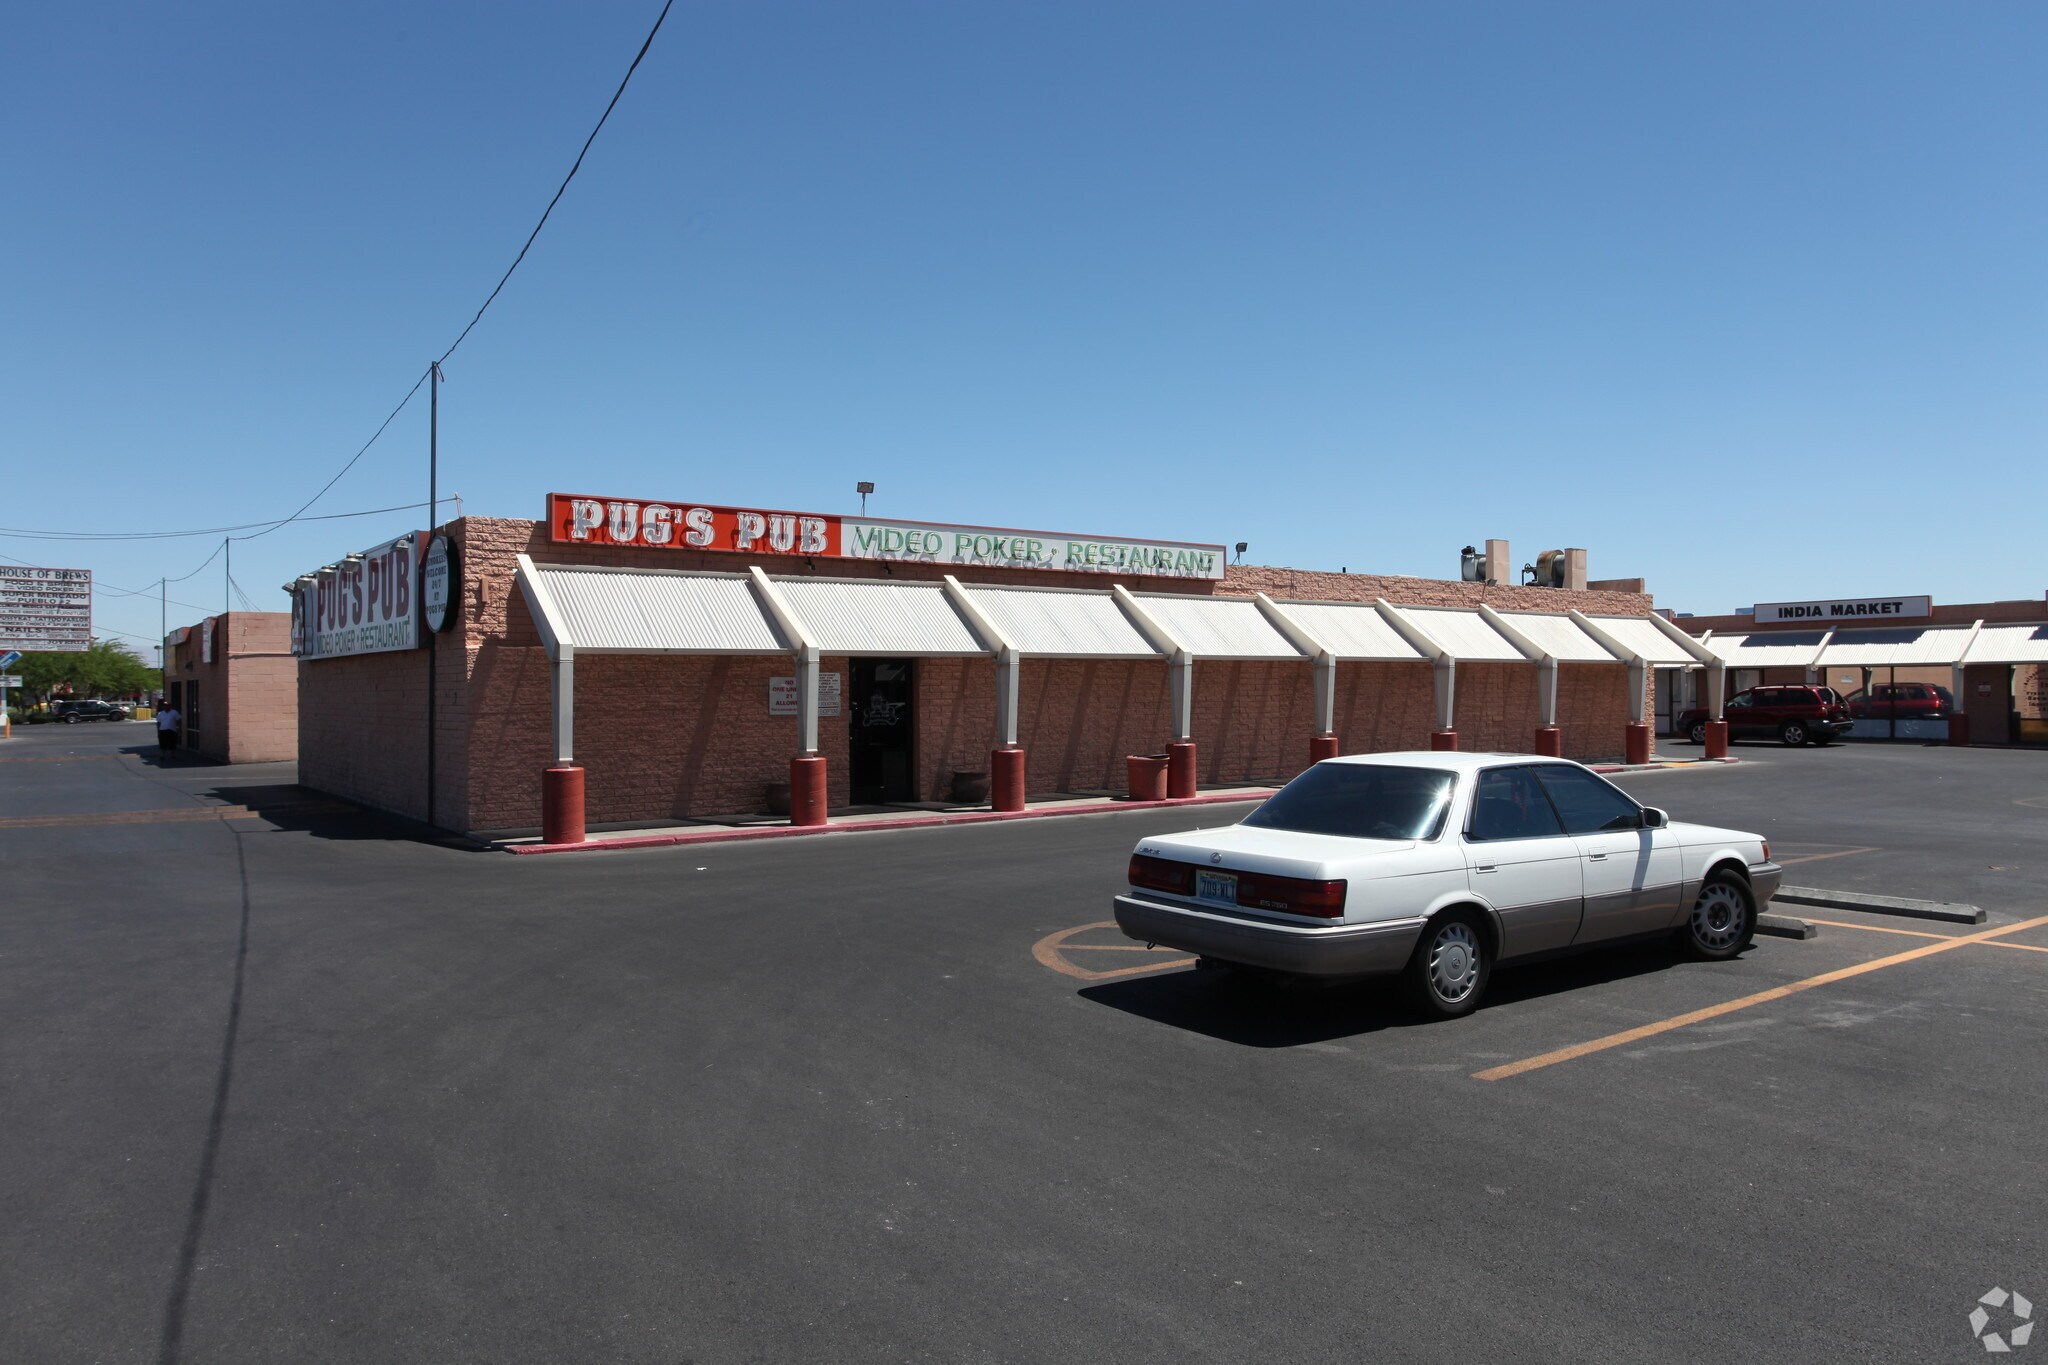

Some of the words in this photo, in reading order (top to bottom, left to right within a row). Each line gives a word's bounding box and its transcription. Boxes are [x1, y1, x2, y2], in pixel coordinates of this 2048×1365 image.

[570, 499, 716, 547] PUG'S
[737, 511, 829, 554] PUB
[855, 526, 943, 555] VIDEO
[954, 533, 1043, 561] POKER
[1066, 541, 1216, 572] RESTAURANT
[0, 568, 33, 578] HOUSE
[37, 570, 51, 578] OF
[55, 571, 89, 580] BREWS
[427, 565, 447, 578] WELCOME
[317, 565, 363, 633] PUG'S
[367, 550, 410, 622] PUB
[1778, 605, 1823, 618] INDIA
[1830, 601, 1903, 616] MARKET
[317, 632, 334, 654] VIDEO
[335, 630, 356, 653] POKER
[360, 619, 409, 649] RESTAURANT
